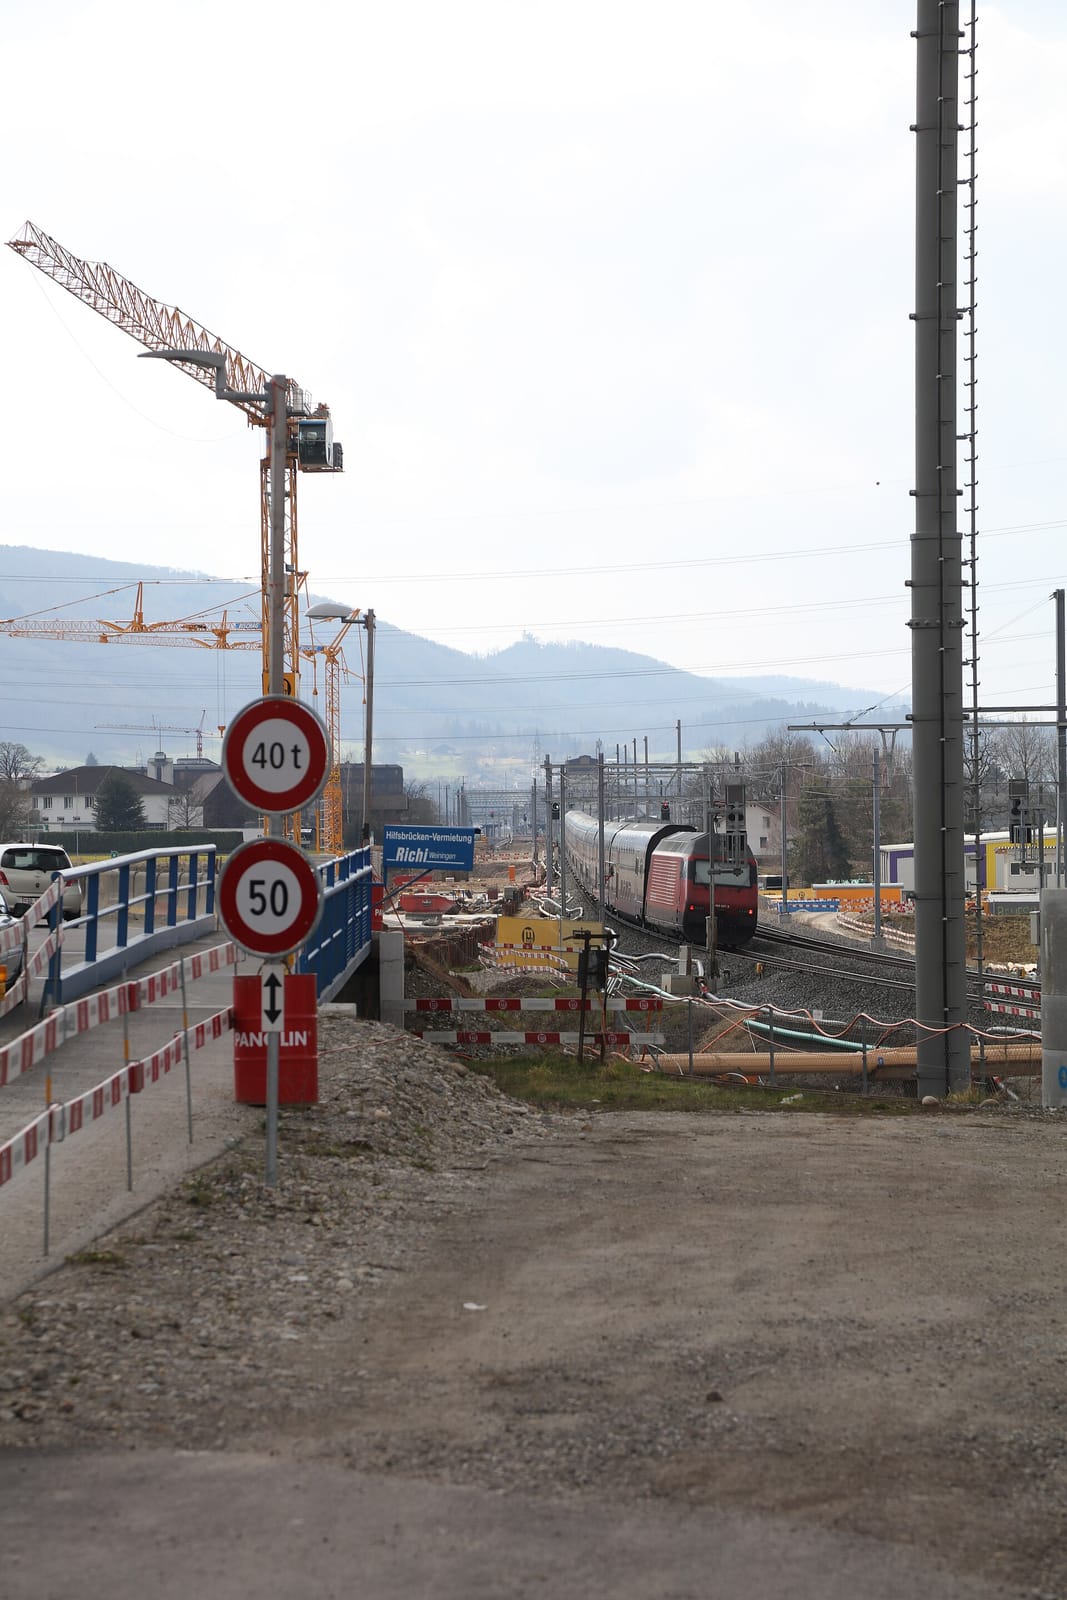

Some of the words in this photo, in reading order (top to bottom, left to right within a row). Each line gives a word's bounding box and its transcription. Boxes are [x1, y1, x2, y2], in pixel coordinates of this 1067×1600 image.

[251, 742, 285, 769] 40
[291, 744, 302, 769] t
[385, 831, 473, 844] Hilfsbrücken-Vermietung
[395, 847, 429, 863] Richi
[249, 879, 289, 917] 50
